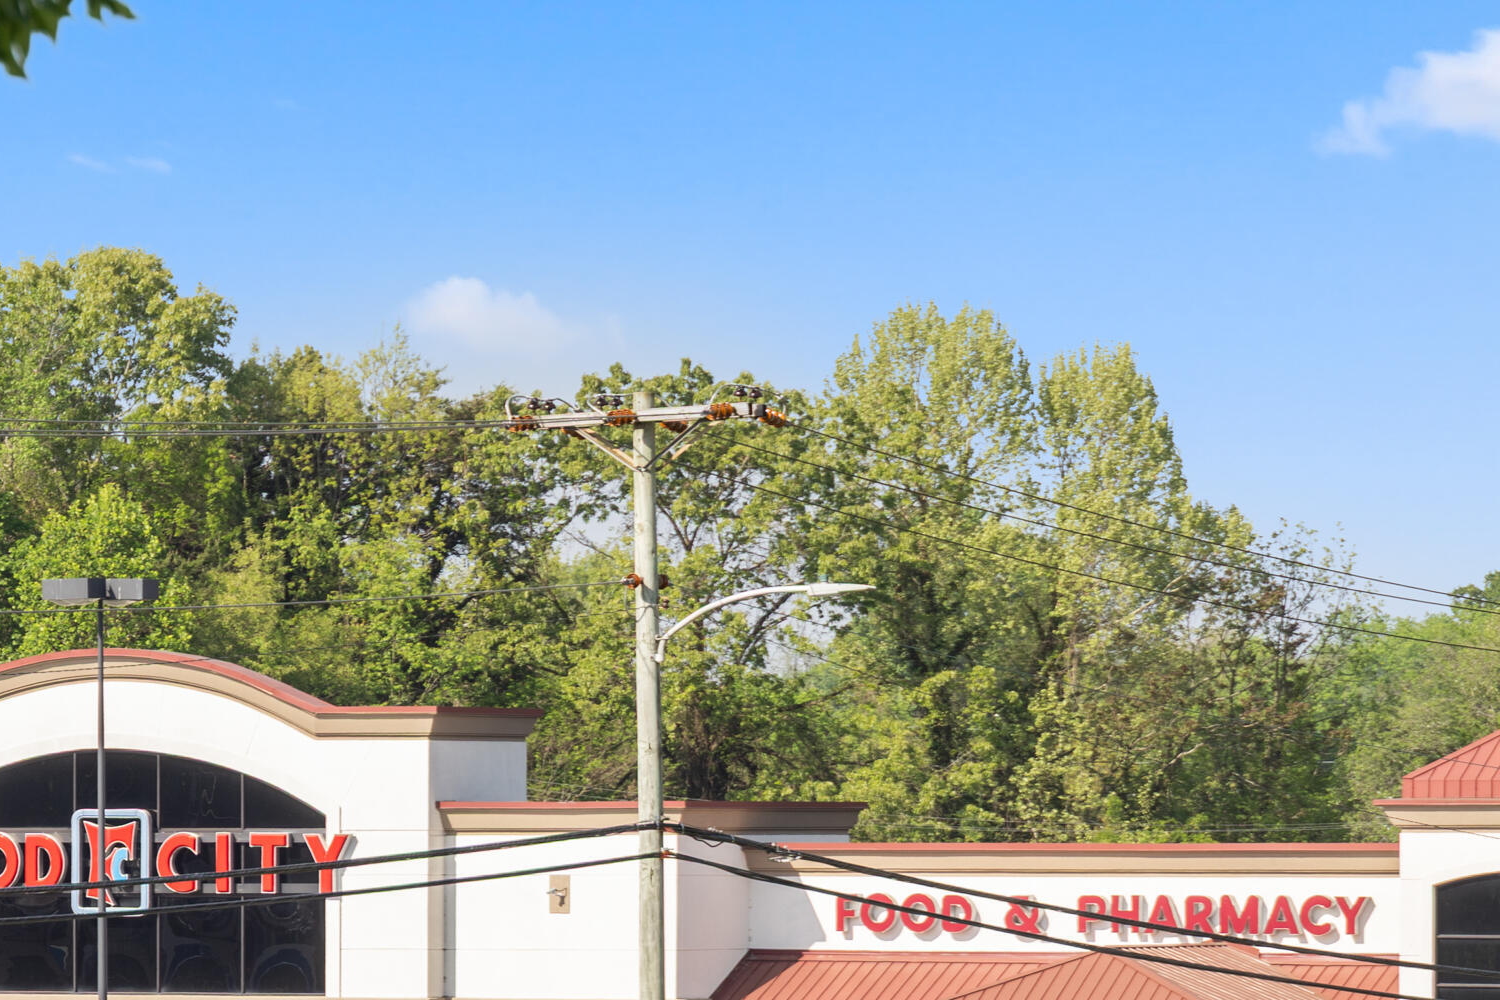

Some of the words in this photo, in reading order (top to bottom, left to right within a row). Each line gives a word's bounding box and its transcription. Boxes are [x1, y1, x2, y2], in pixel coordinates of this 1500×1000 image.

[156, 832, 349, 895] CITY
[836, 893, 974, 933] FOOD
[1004, 895, 1042, 934] &
[1077, 894, 1375, 937] PHARMACY
